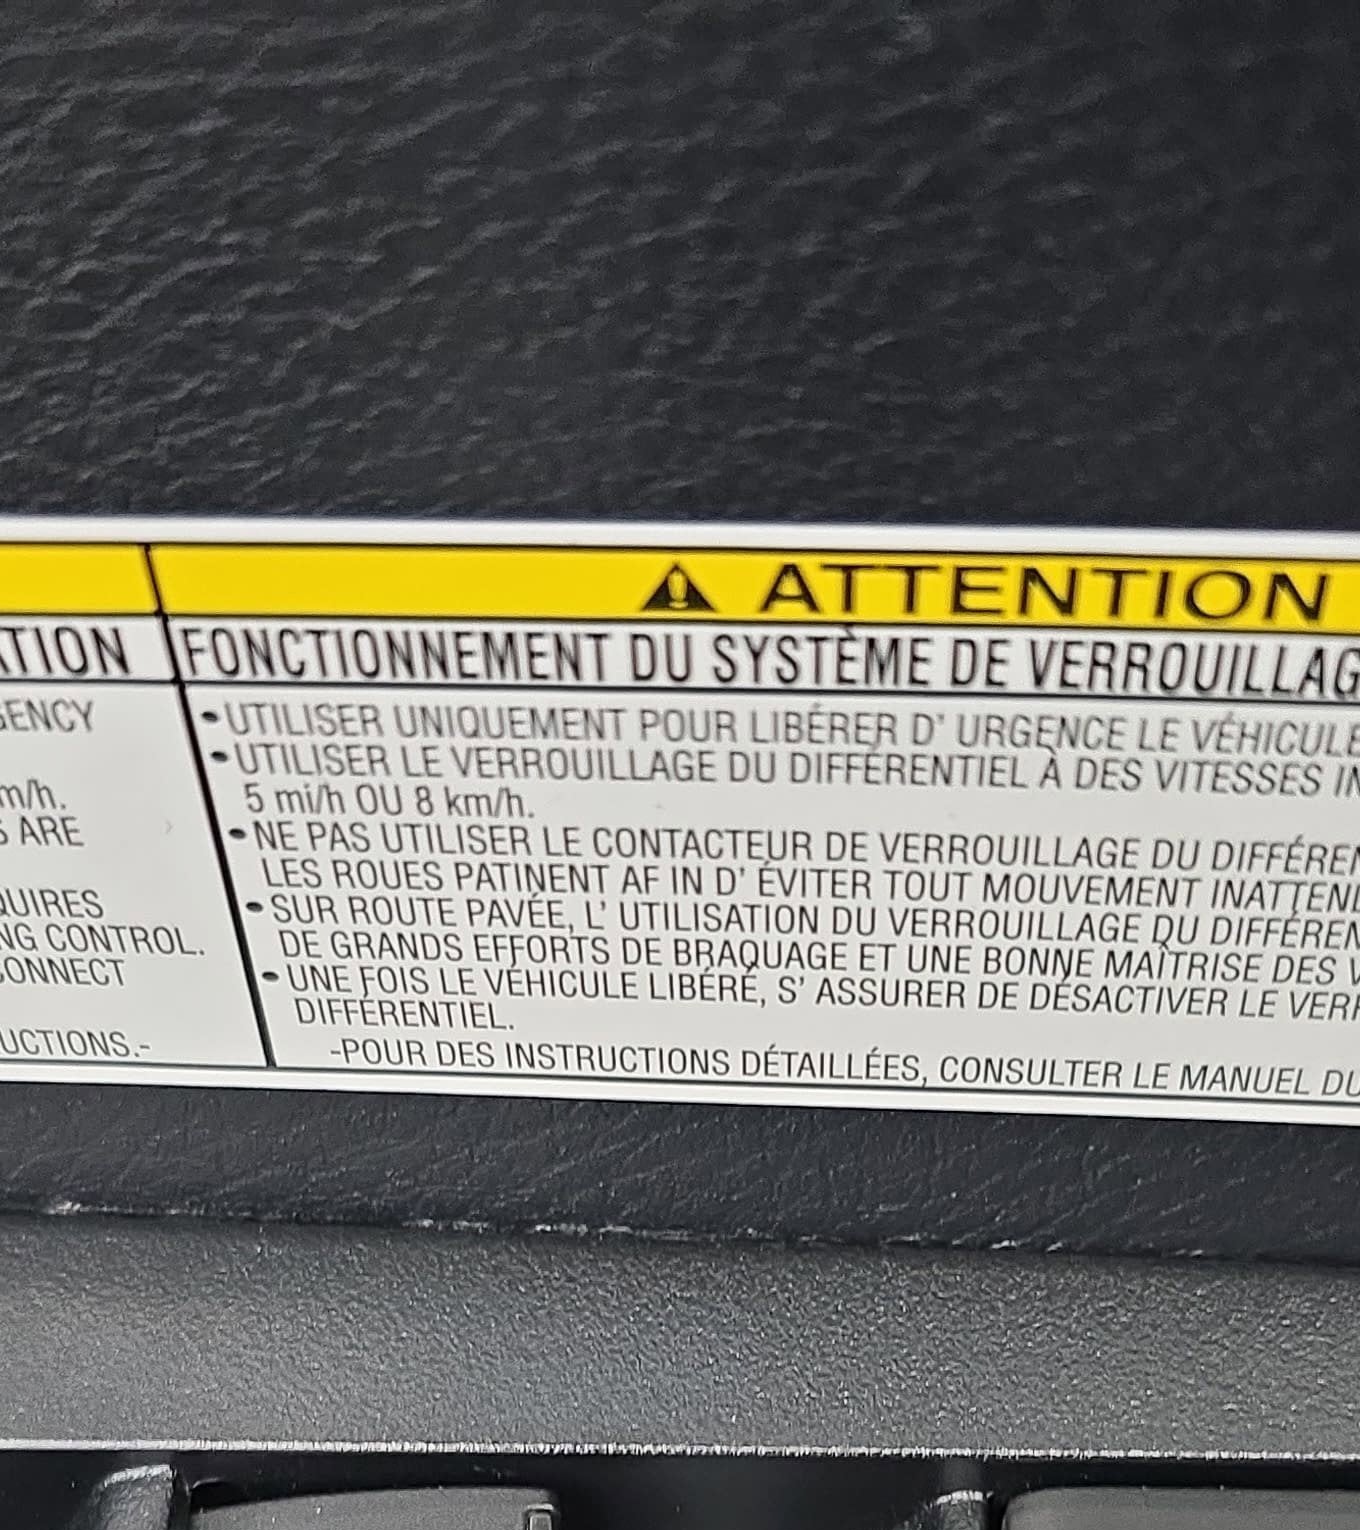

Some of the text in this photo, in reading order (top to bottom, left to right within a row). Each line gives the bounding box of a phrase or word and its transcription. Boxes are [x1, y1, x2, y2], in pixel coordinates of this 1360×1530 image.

[760, 563, 1330, 622] ATTENTION
[179, 628, 613, 684] FONCTIONNEMENT
[628, 634, 694, 685] DU
[711, 628, 935, 689] SYSTÈME
[949, 639, 1012, 691] DE
[223, 701, 385, 738] UTILISER
[392, 704, 629, 742] UNIQUEMENT
[637, 708, 739, 744] POUR
[749, 702, 898, 747] LIBÉRER
[232, 741, 393, 778] UTILISER
[448, 745, 718, 784] VERROUILLAGE
[788, 744, 1029, 790] DIFFÉRENTIEL
[1038, 747, 1063, 790] À
[1073, 756, 1145, 793] DES
[1154, 758, 1324, 798] VITESSES
[242, 781, 266, 814] 5
[354, 783, 404, 817] OU
[413, 784, 436, 818] 8
[442, 785, 536, 820] km/h.
[18, 814, 85, 846] ARE
[251, 819, 300, 852] NE
[305, 820, 372, 853] PAS
[379, 821, 533, 857] UTILISER
[591, 826, 813, 862] CONTACTEUR
[877, 831, 1142, 871] VERROUILLAGE
[260, 856, 323, 889] LES
[330, 858, 445, 891] ROUES
[453, 860, 611, 895] PATINENT
[881, 869, 974, 903] TOUT
[981, 871, 1203, 910] MOUVEMENT
[44, 922, 206, 955] CONTROL.
[269, 892, 340, 924] SUR
[346, 894, 458, 927] ROUTE
[465, 889, 575, 937] PAVÉE,
[887, 905, 1143, 945] VERROUILLAGE
[329, 929, 464, 962] GRANDS
[472, 932, 611, 965] EFFORTS
[672, 937, 848, 972] BRAQUAGE
[858, 941, 898, 973] ET
[907, 942, 974, 975] UNE
[982, 945, 1096, 979] BONNE
[1103, 942, 1264, 984] MAÎTRISE
[1270, 954, 1338, 987] DES
[285, 962, 354, 992] UNE
[358, 964, 430, 994] FOIS
[482, 959, 639, 1000] VÉHICULE
[648, 964, 766, 1010] LIBÉRÉ,
[1028, 974, 1229, 1018] DÉSACTIVER
[293, 991, 515, 1031] DIFFÉRENTIEL.
[435, 1039, 496, 1069] DES
[504, 1041, 731, 1076] INSTRUCTIONS
[741, 1042, 928, 1089] DÉTAILLÉES,
[939, 1055, 1124, 1089] CONSULTER
[1178, 1063, 1311, 1096] MANUEL
